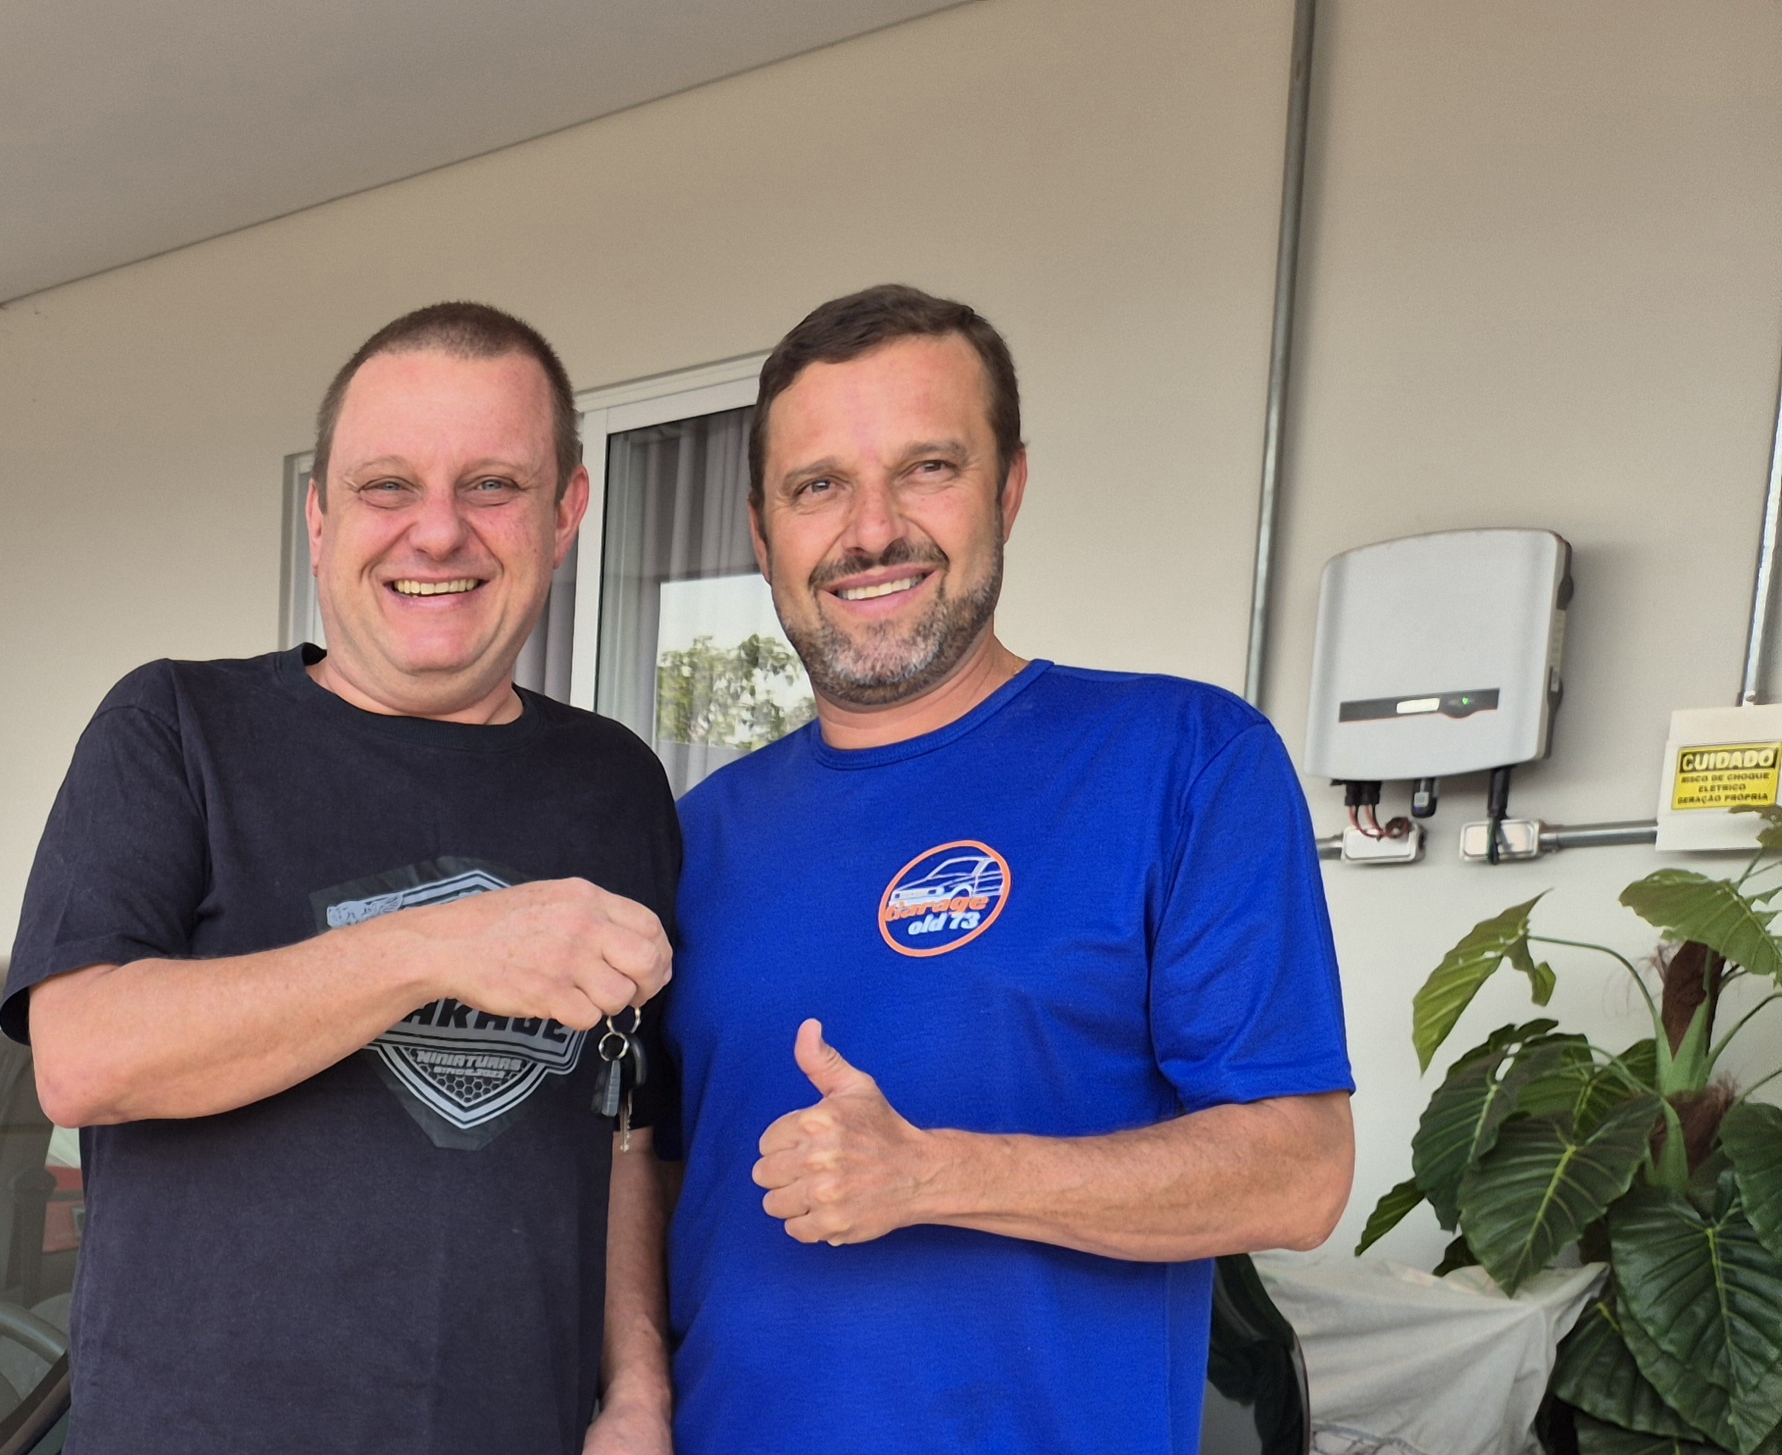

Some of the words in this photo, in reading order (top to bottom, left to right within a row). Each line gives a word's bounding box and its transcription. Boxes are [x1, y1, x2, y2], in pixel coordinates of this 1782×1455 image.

[1682, 750, 1774, 771] CUIDADO
[1727, 773, 1769, 781] CHOQUE
[885, 896, 989, 922] Garage
[909, 914, 948, 935] old
[950, 912, 981, 929] 73
